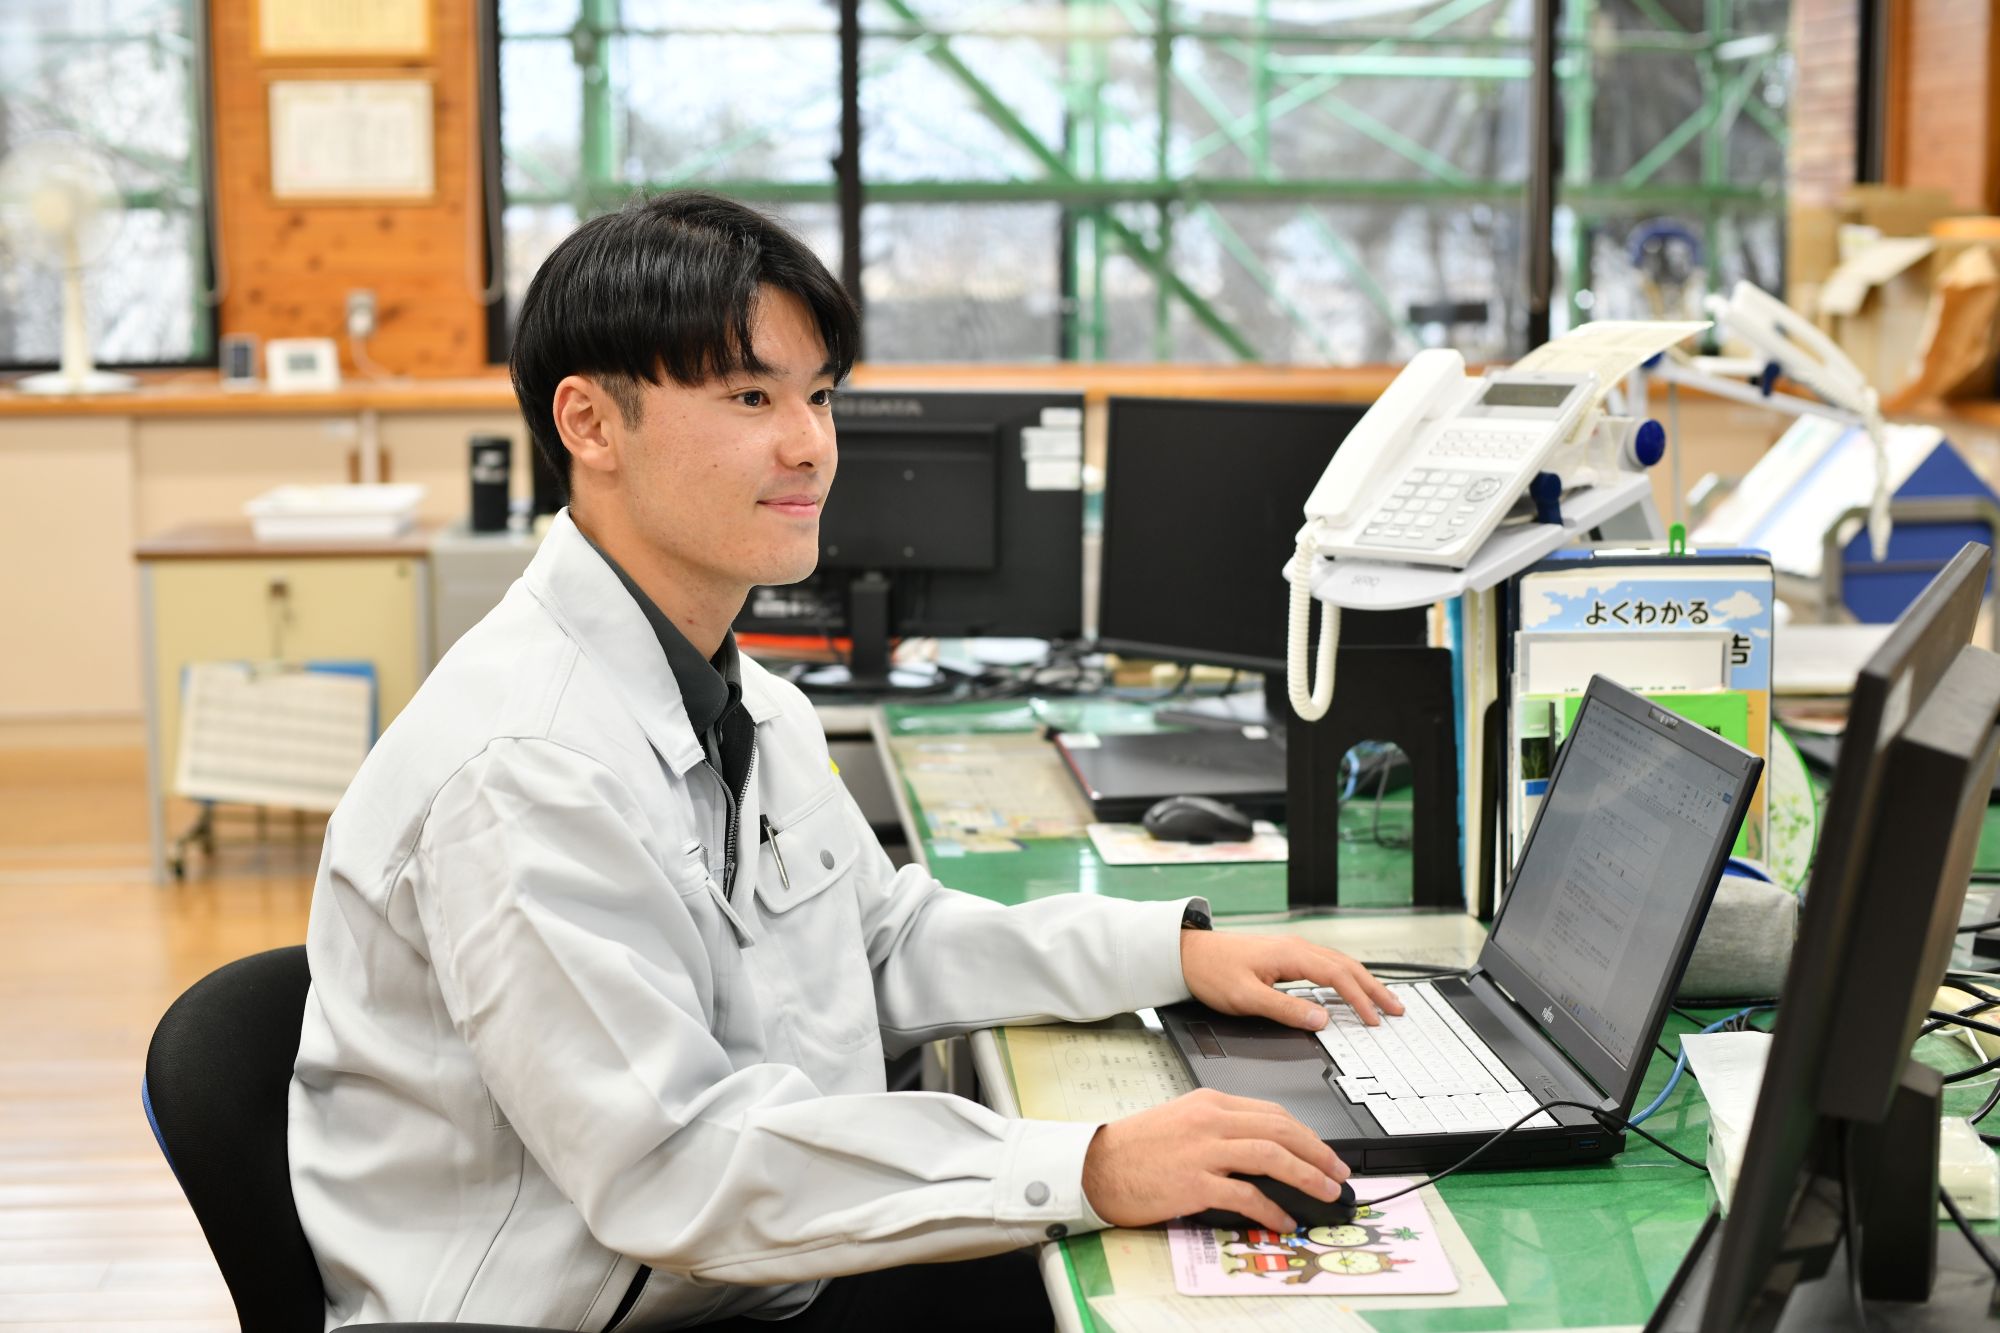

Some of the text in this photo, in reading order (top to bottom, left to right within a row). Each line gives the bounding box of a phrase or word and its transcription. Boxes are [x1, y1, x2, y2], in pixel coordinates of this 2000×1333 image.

[1586, 600, 1709, 625] よくわかる
